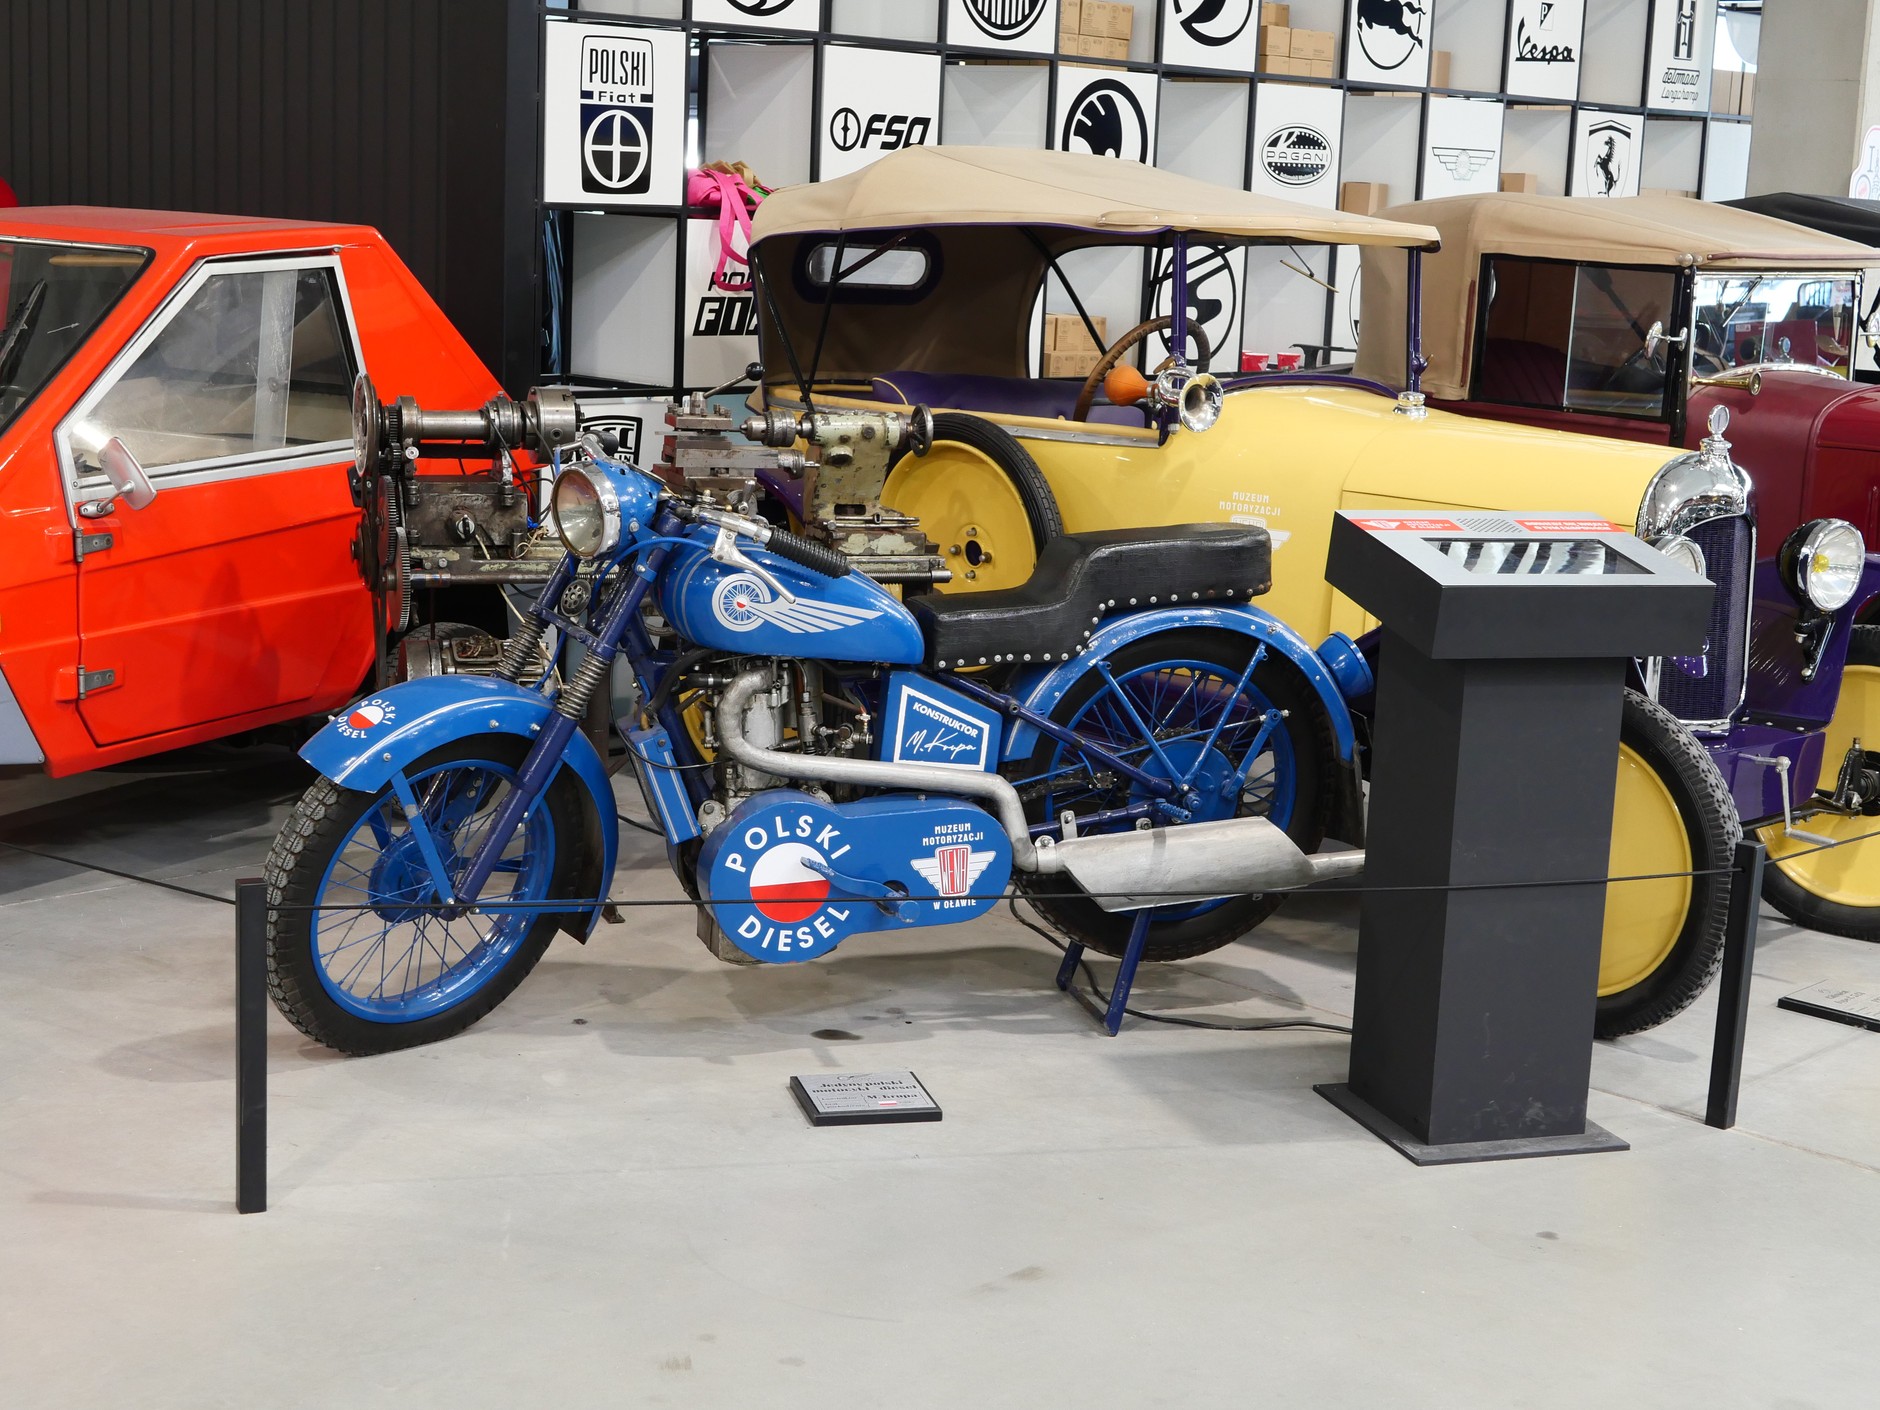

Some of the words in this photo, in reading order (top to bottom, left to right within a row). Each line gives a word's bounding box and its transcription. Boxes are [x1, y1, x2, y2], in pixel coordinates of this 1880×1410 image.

[1515, 16, 1576, 66] Vespa
[589, 48, 646, 87] POLSKI
[598, 91, 637, 104] Fiat
[1266, 150, 1329, 163] PAGANI
[1232, 491, 1270, 504] MUZEUM
[1219, 501, 1281, 517] MOTORYZACJI
[361, 698, 397, 725] POLSKI
[912, 701, 979, 739] KONSTRUKTOR
[336, 715, 368, 739] DIESEL
[934, 822, 972, 835] MUZEUM
[724, 814, 851, 874] POLSKI
[922, 831, 984, 847] MOTORYZACJI
[932, 901, 942, 911] W
[943, 898, 977, 910] OŁAWIE
[737, 906, 851, 952] DIESEL
